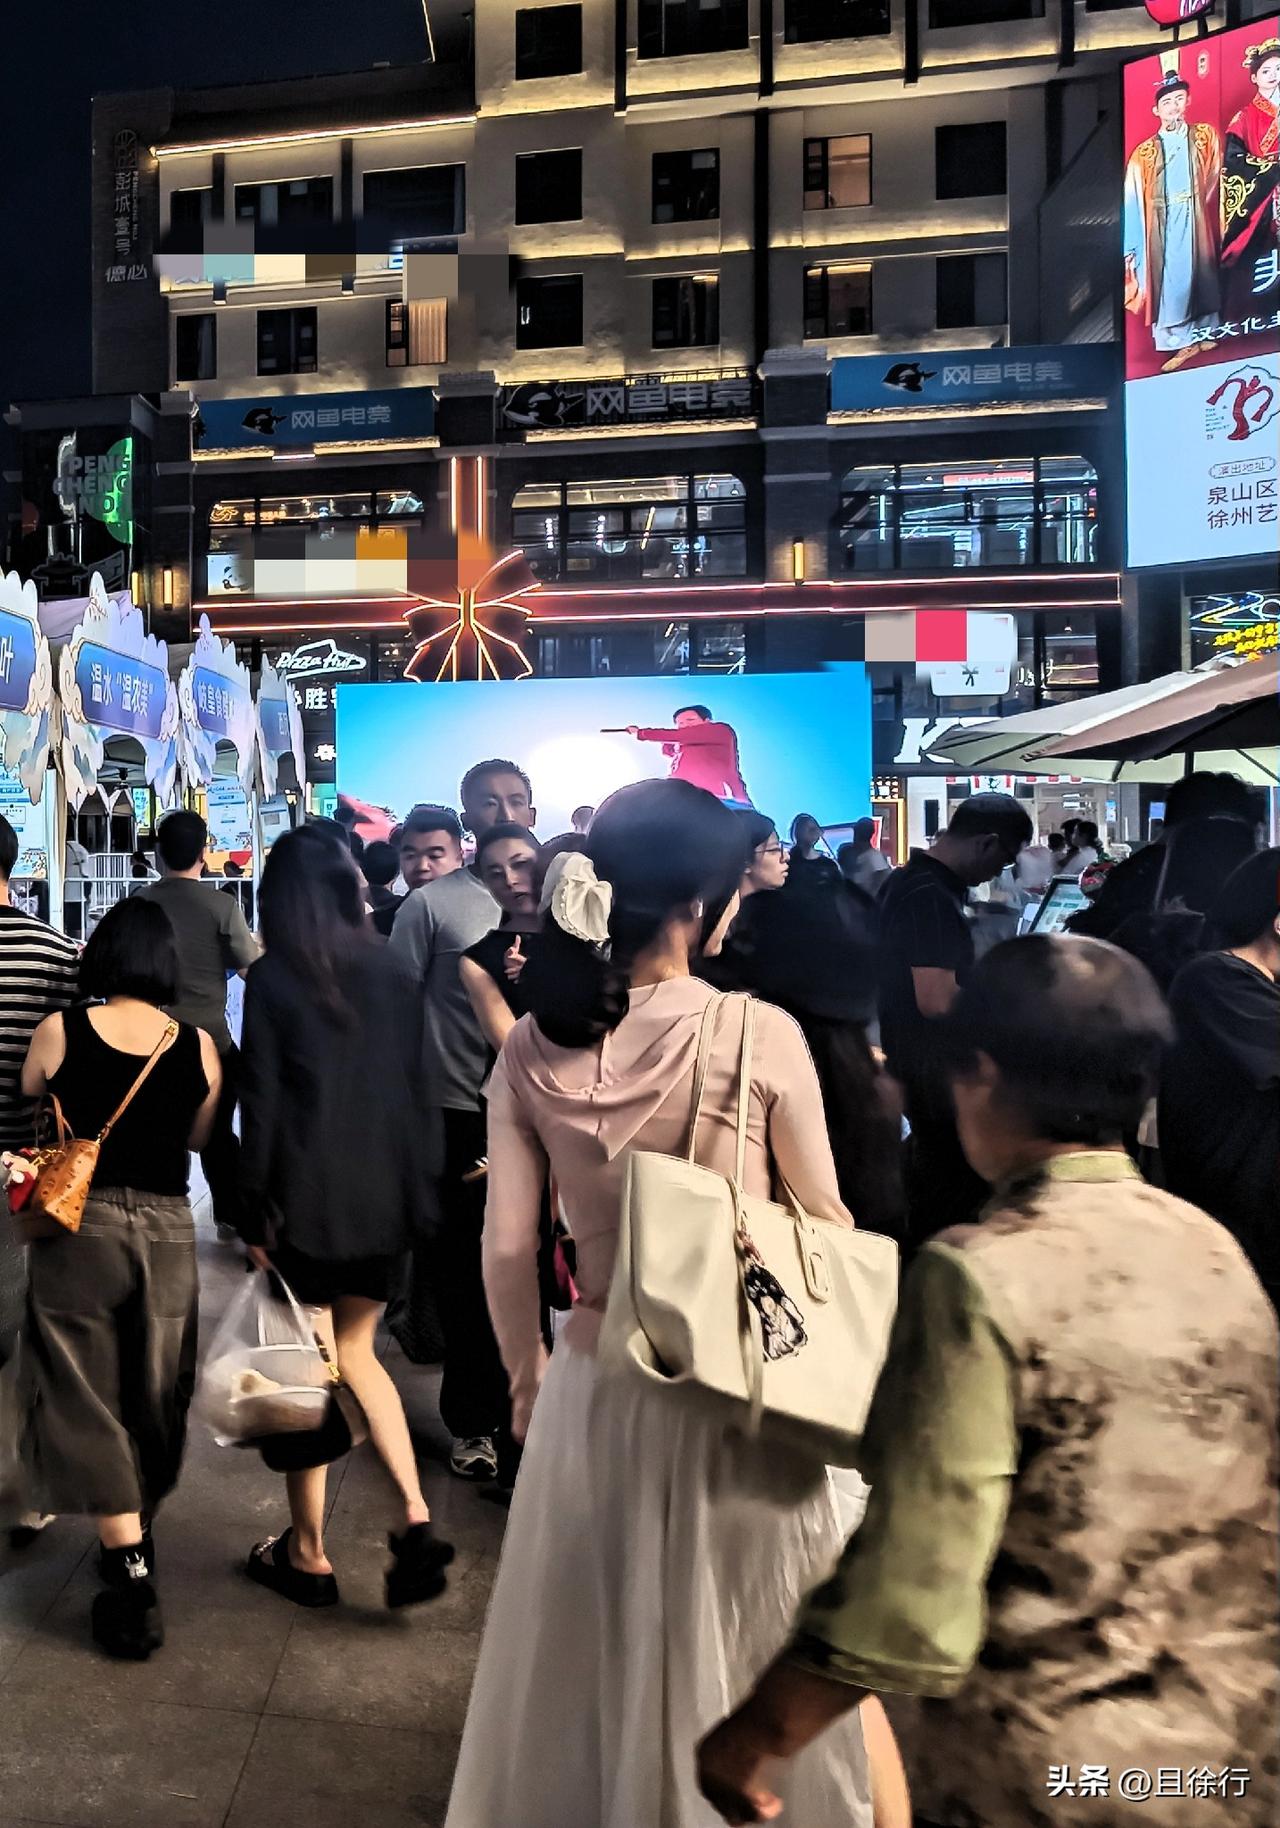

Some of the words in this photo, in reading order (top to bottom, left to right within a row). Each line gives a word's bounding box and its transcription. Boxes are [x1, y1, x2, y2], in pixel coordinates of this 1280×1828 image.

[114, 172, 131, 256] 彭城壹号
[942, 361, 1064, 386] 网鱼电竞
[586, 378, 751, 416] 网鱼电竞
[291, 405, 391, 430] 网鱼电竞
[1208, 478, 1278, 505] 泉山区
[1207, 503, 1278, 530] 徐州艺
[276, 651, 322, 669] Pizza
